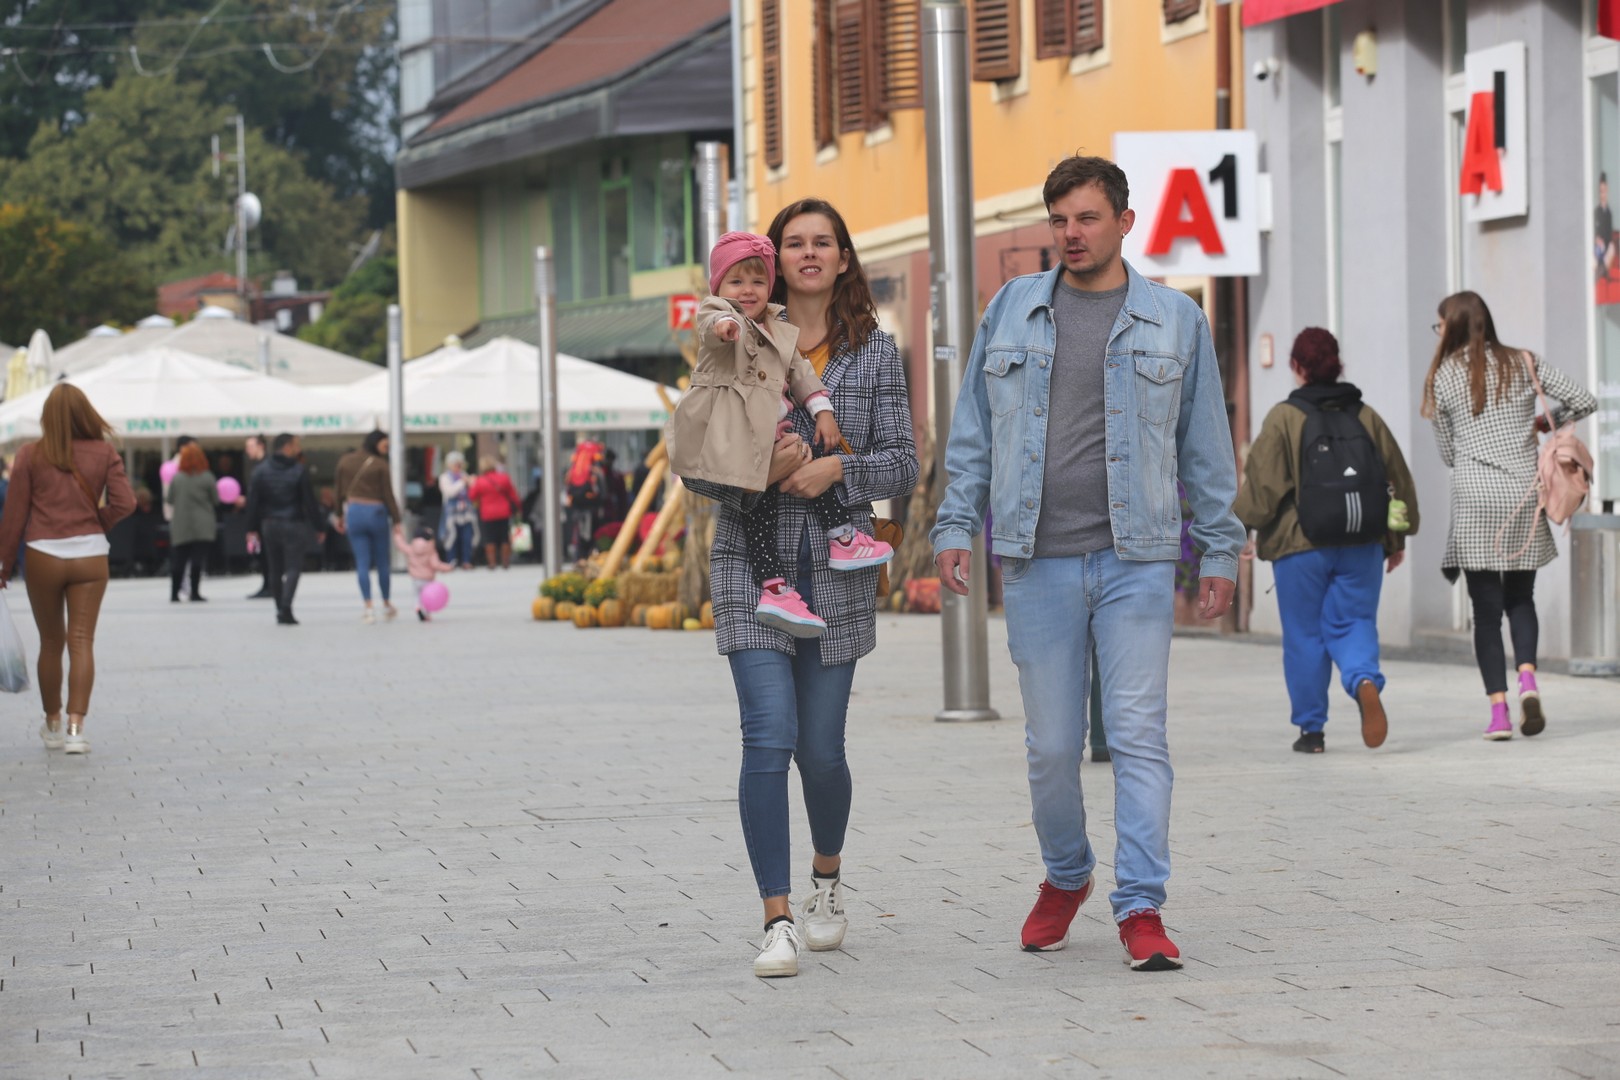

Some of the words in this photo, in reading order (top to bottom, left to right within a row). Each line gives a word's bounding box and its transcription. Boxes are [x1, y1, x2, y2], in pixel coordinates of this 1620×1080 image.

[1143, 153, 1237, 256] A1
[219, 415, 260, 430] PAN
[302, 414, 341, 428] PAN
[480, 411, 519, 425] PAN
[568, 410, 607, 423] PAN
[126, 418, 167, 432] PAN
